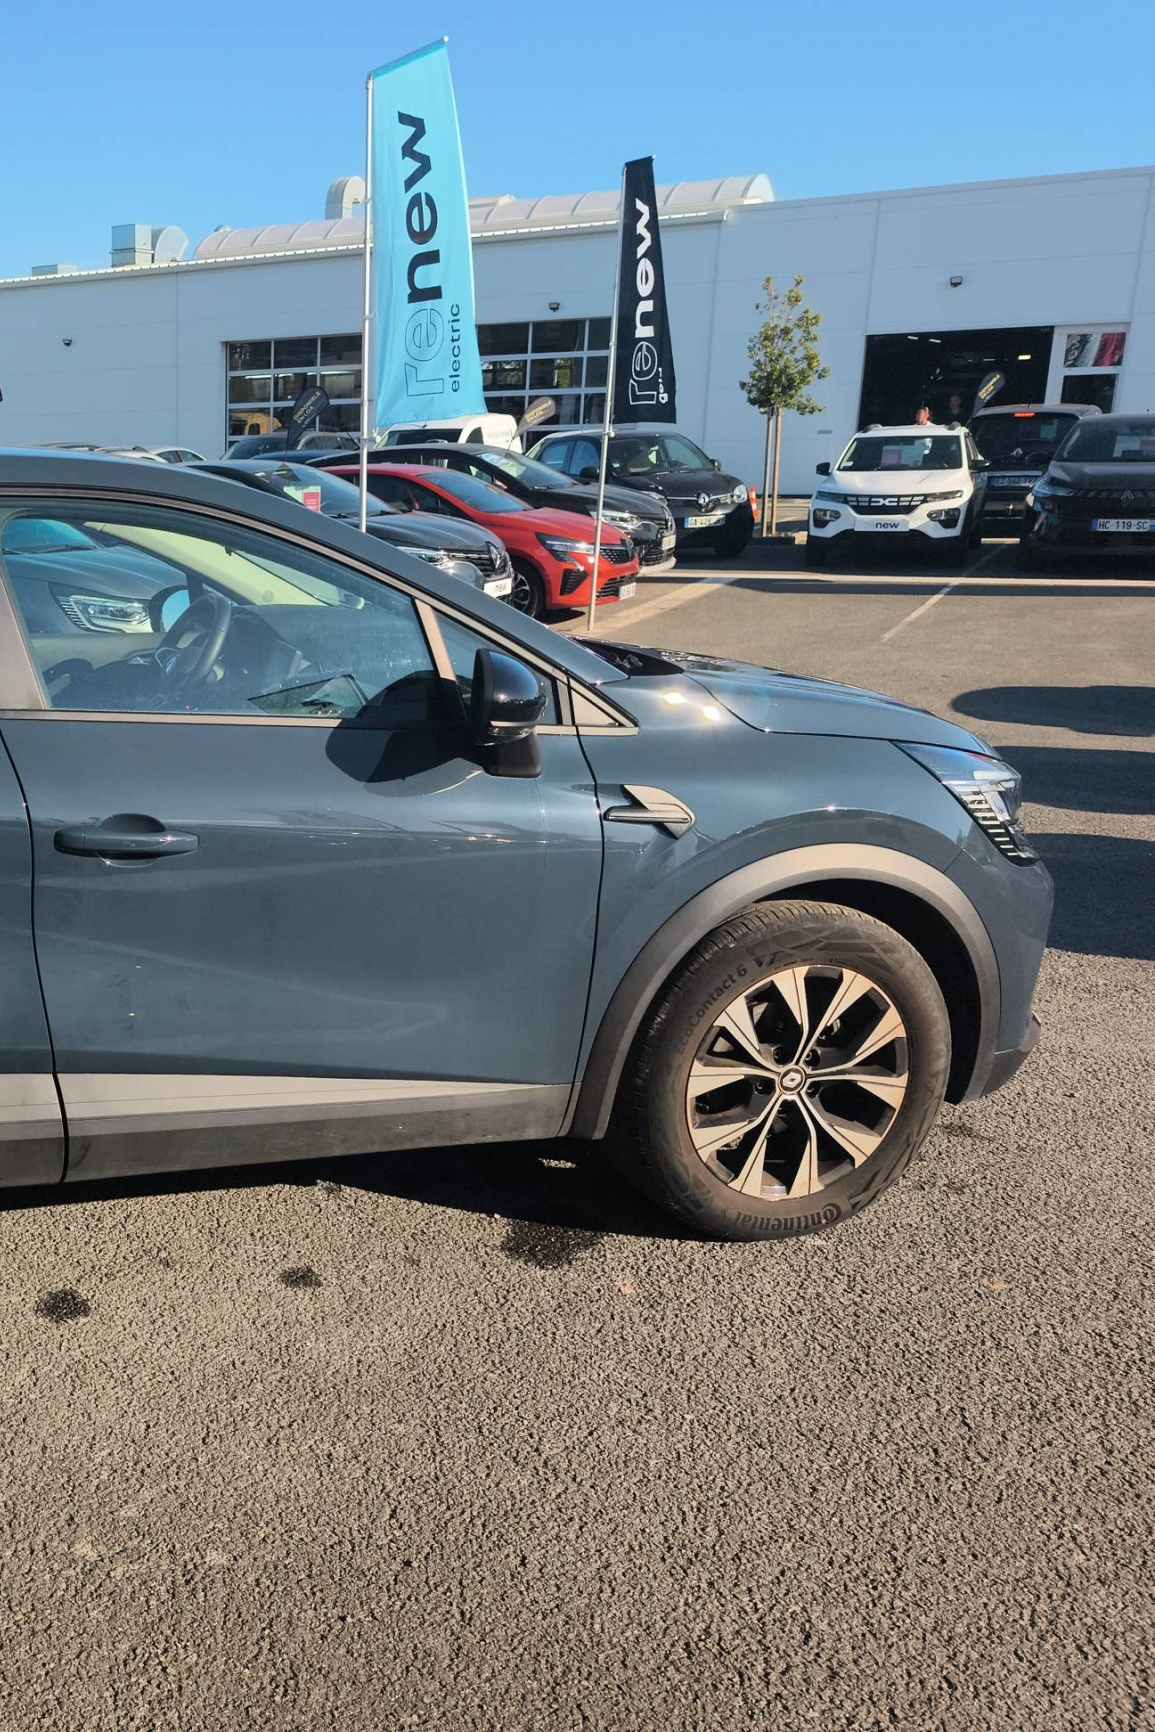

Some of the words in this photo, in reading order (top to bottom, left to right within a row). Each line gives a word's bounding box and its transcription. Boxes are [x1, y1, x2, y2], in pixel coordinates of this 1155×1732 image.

[397, 110, 445, 398] renew
[628, 197, 658, 405] renew
[448, 303, 461, 394] electric
[875, 520, 900, 530] new
[676, 973, 737, 1055] EcoContact
[736, 963, 748, 978] 6
[733, 1202, 842, 1233] Continental
